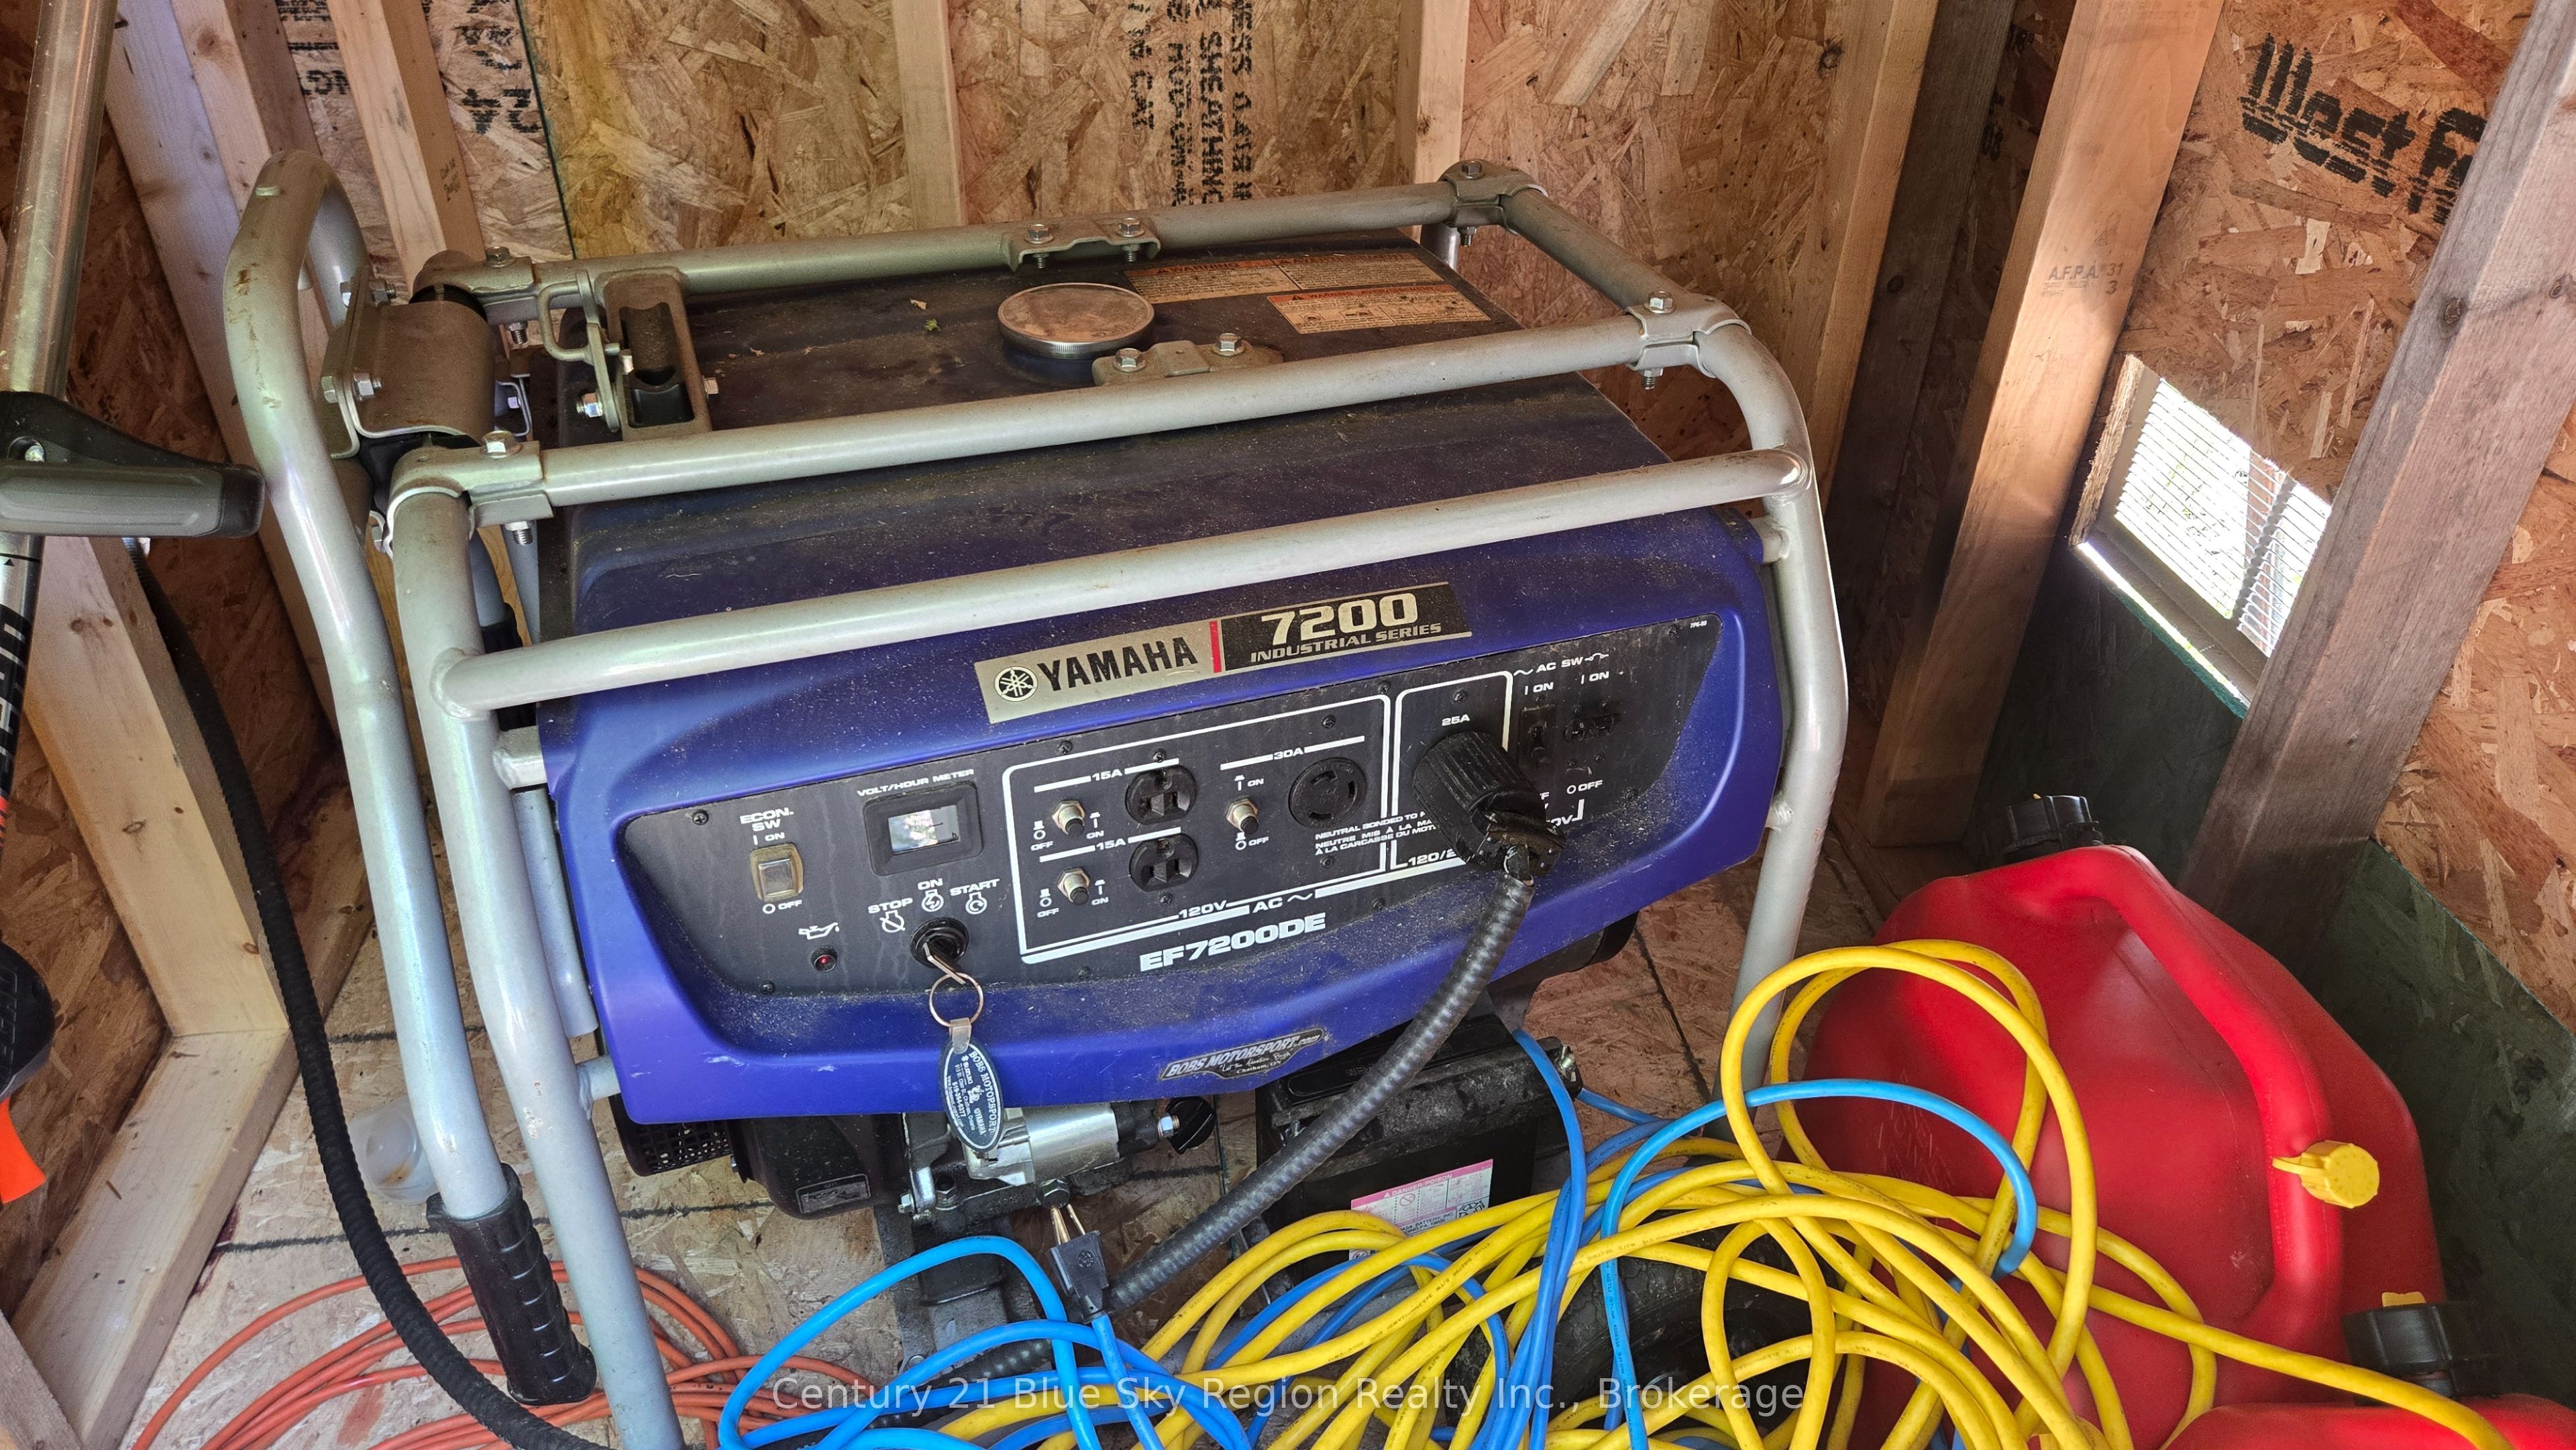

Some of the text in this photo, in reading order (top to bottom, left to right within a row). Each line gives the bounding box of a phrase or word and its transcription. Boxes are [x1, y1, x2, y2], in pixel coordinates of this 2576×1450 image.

[1260, 591, 1419, 646] 7200
[1250, 621, 1442, 663] INDUSTRIAL SERIES
[1038, 636, 1199, 691] YAMAHA
[1536, 656, 1584, 674] AC SW
[1589, 671, 1609, 682] ON
[1533, 682, 1554, 693] ON
[1442, 714, 1470, 726] 25A
[1273, 747, 1305, 761] 30A
[857, 769, 975, 797] VOLT/HOUR METER
[1093, 769, 1123, 782] 15A
[1247, 777, 1264, 786] ON
[1578, 779, 1603, 792] OFF
[740, 808, 794, 825] ECON.
[752, 819, 781, 831] SW
[1315, 826, 1360, 840] NEUTRAL
[1362, 816, 1403, 830] BONDED
[1405, 813, 1417, 821] TO
[765, 832, 785, 842] ON
[1086, 830, 1104, 839] ON
[1248, 836, 1269, 846] OFF
[1315, 835, 1356, 849] NEUTRE
[1362, 829, 1381, 839] MIS
[1399, 821, 1412, 831] LA
[1340, 832, 1394, 850] CARCASSE
[1396, 829, 1409, 838] DU
[1030, 841, 1054, 851] OFF
[1096, 839, 1126, 851] 15A
[918, 878, 943, 891] ON
[950, 878, 1000, 896] START
[778, 900, 802, 911] OFF
[868, 897, 913, 915] STOP
[1091, 896, 1109, 906] ON
[1178, 897, 1283, 919] 120V AC
[1037, 908, 1059, 918] OFF
[1140, 913, 1326, 972] EF7200DE
[963, 1062, 974, 1085] SUZUKI
[1165, 1058, 1208, 1078] BOBS
[969, 1051, 997, 1133] BOBS MOTORSPORT
[976, 1112, 987, 1135] YAMAHA
